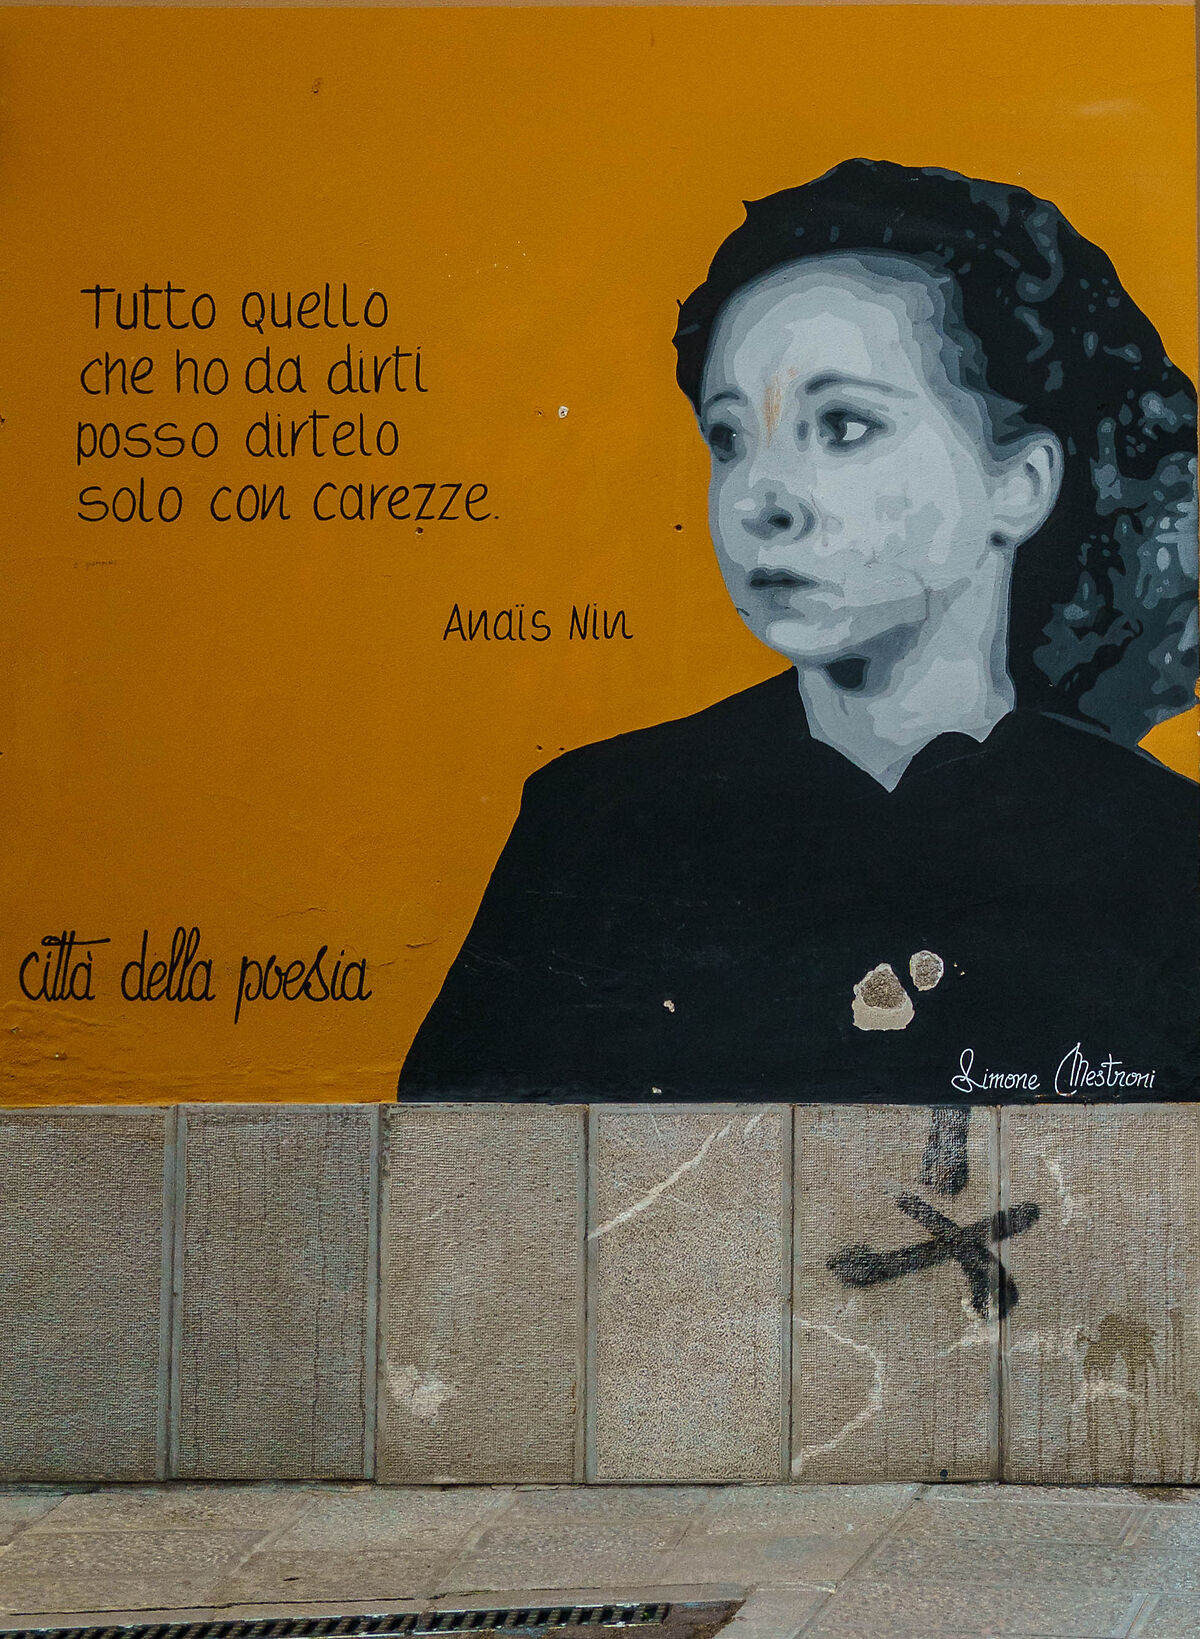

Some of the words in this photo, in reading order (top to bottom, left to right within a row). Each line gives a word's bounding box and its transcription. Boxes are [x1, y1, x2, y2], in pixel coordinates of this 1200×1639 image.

[80, 281, 216, 330] Tutto
[80, 352, 154, 395] che
[176, 349, 229, 395] ho
[245, 346, 307, 393] da
[327, 344, 428, 395] dirti
[77, 421, 219, 466] posso
[246, 410, 400, 458] dirtelo
[78, 478, 183, 522] solo
[211, 484, 290, 522] con
[314, 482, 500, 522] carezze.
[443, 603, 551, 641] Anaïs
[569, 603, 633, 641] Nin
[19, 930, 111, 1002] città
[121, 926, 216, 1002] della
[234, 945, 373, 1025] poesia
[951, 1048, 1040, 1093] Simone
[1054, 1042, 1156, 1097] Mestroni
